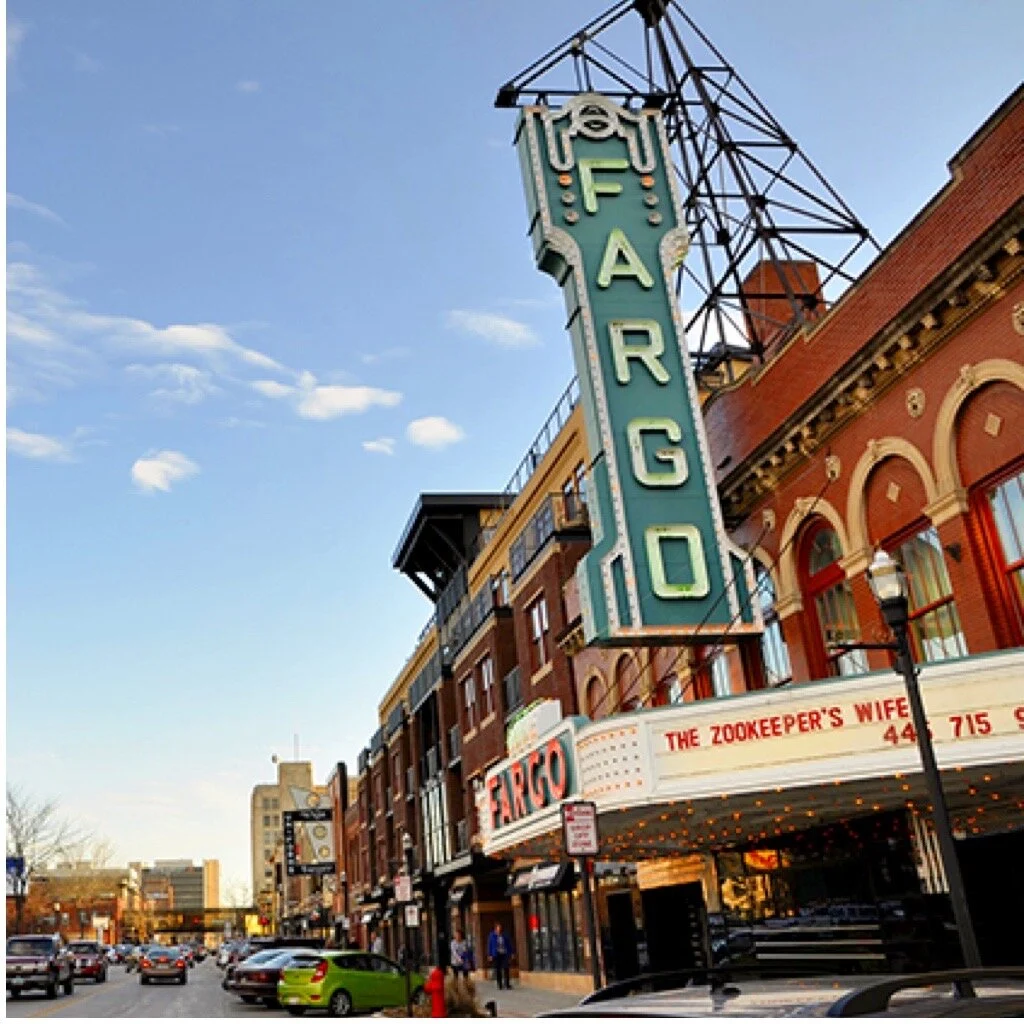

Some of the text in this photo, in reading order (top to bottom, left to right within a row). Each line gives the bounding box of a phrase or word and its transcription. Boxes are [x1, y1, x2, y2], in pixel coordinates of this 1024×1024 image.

[578, 158, 710, 600] FARGO
[664, 696, 909, 752] THE ZOOKEEPER'S WIFE
[486, 736, 567, 830] FARGO
